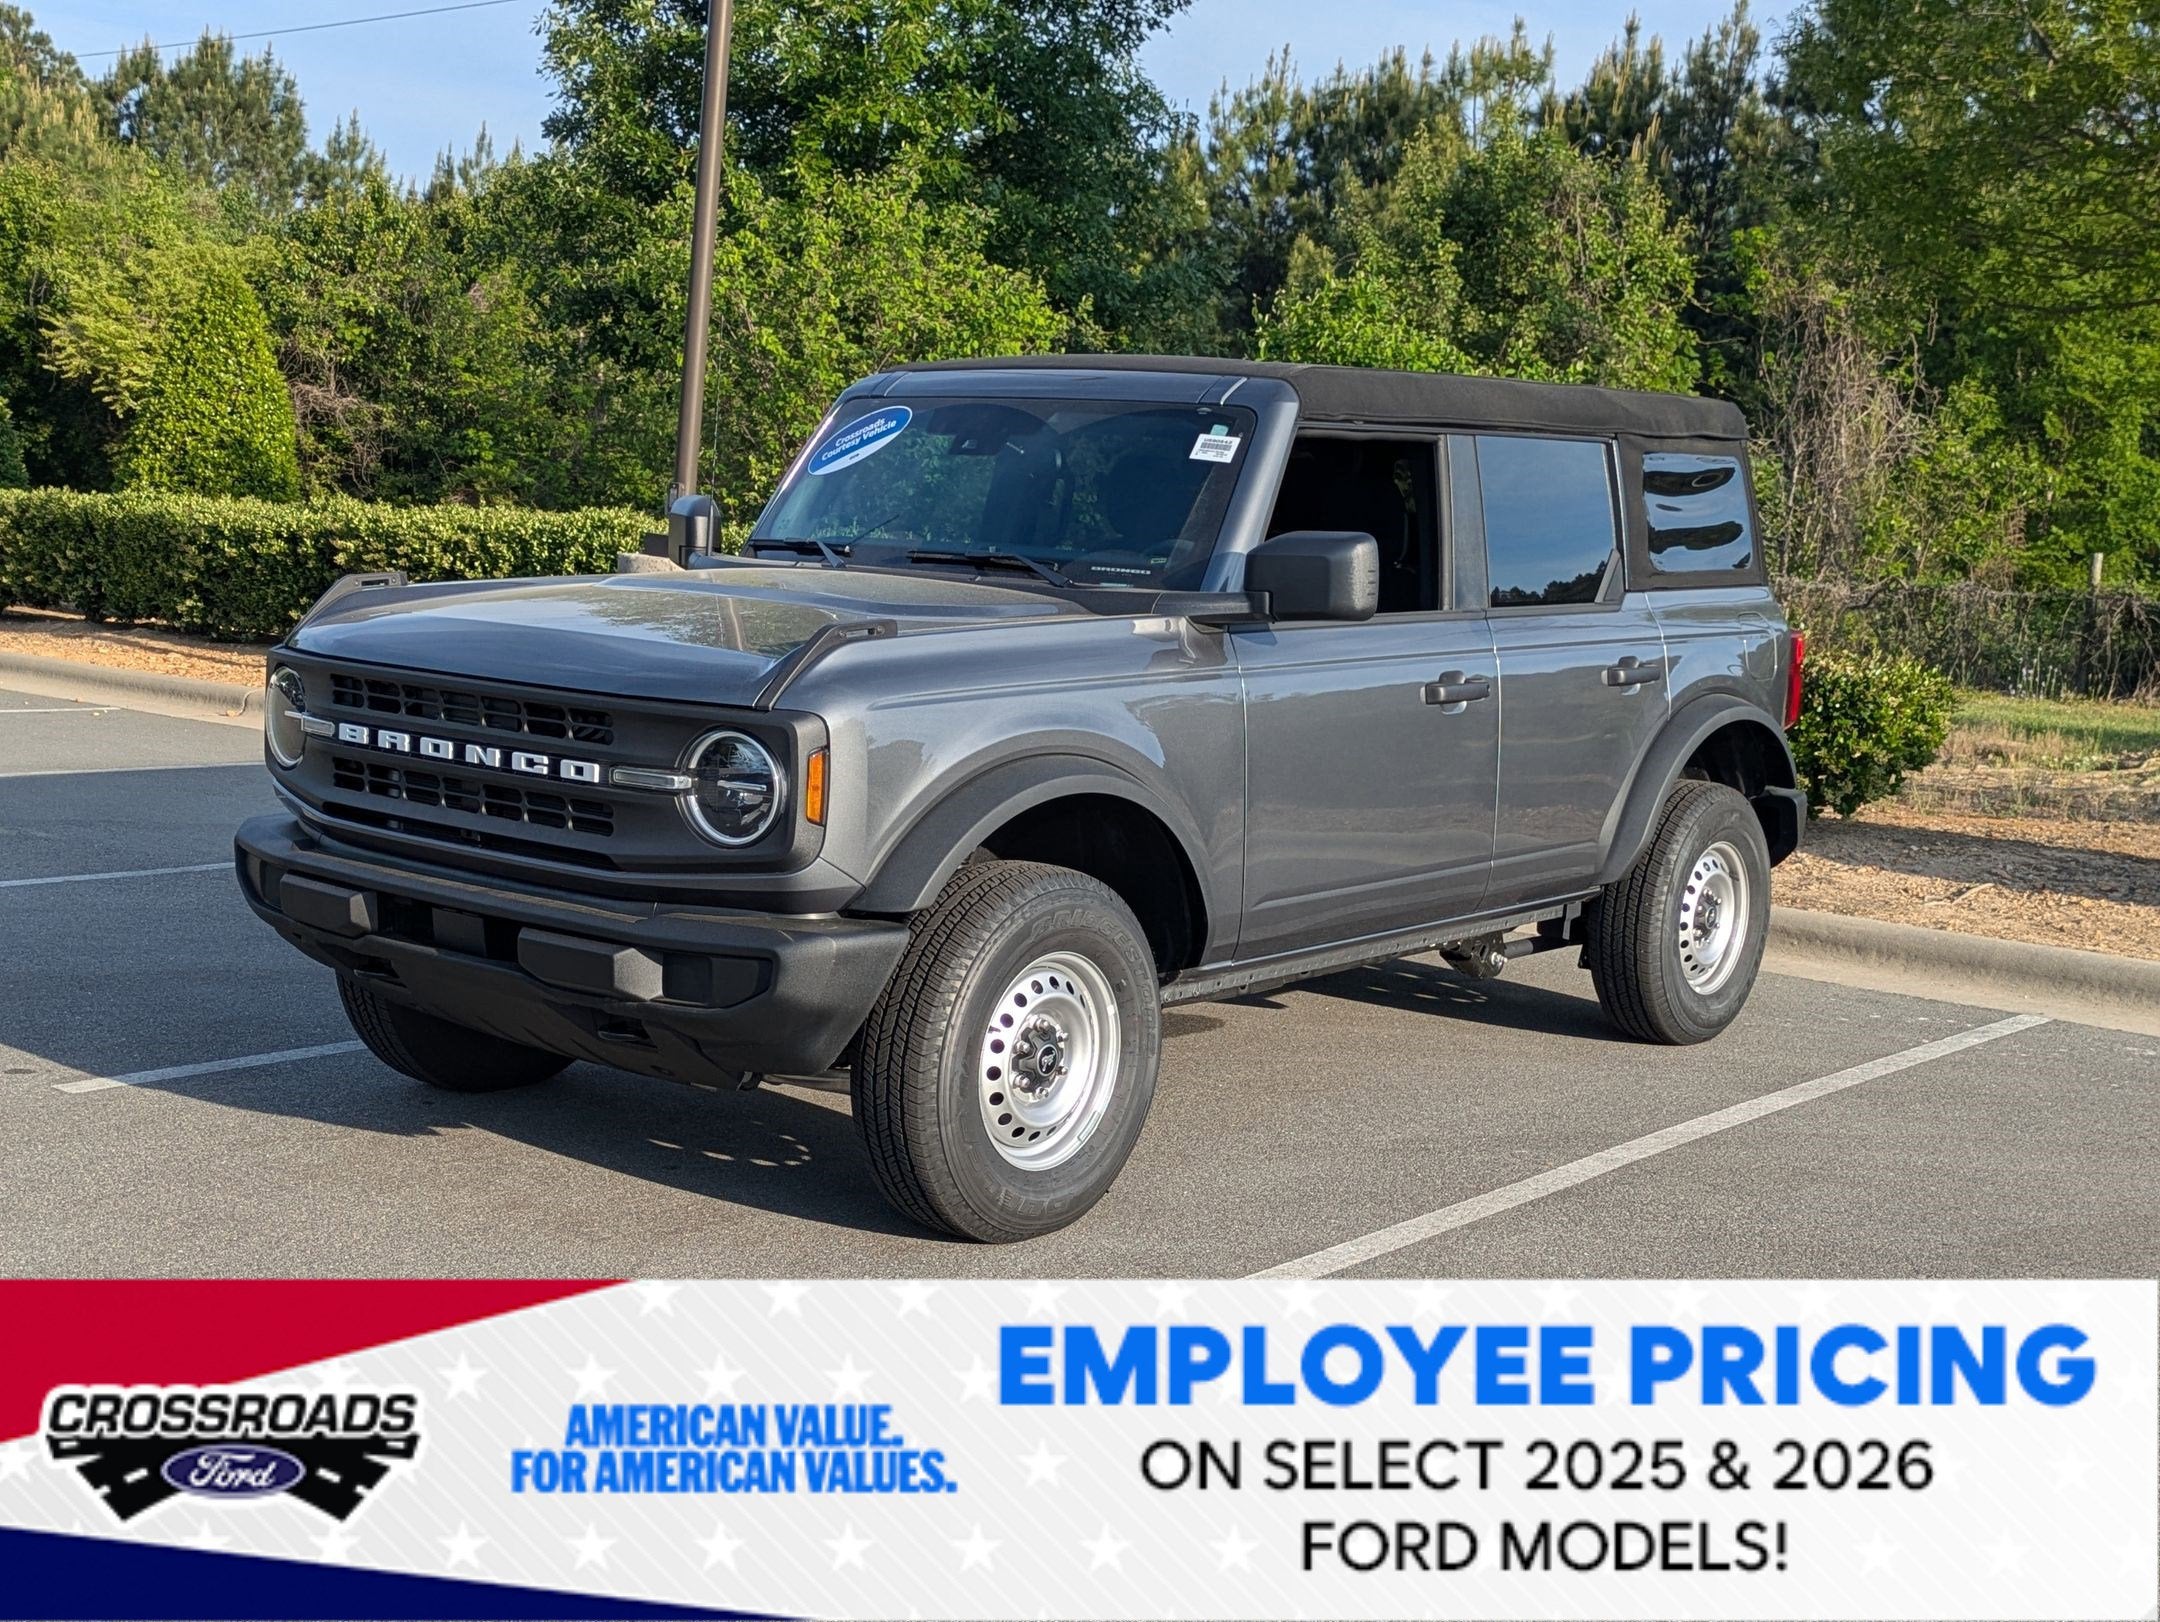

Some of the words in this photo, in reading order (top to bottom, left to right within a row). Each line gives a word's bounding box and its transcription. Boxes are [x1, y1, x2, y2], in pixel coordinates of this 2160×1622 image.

[822, 437, 862, 460] Courtesy
[862, 420, 897, 441] Vehicle
[835, 417, 886, 447] Crossroads
[338, 722, 600, 783] BRONCO
